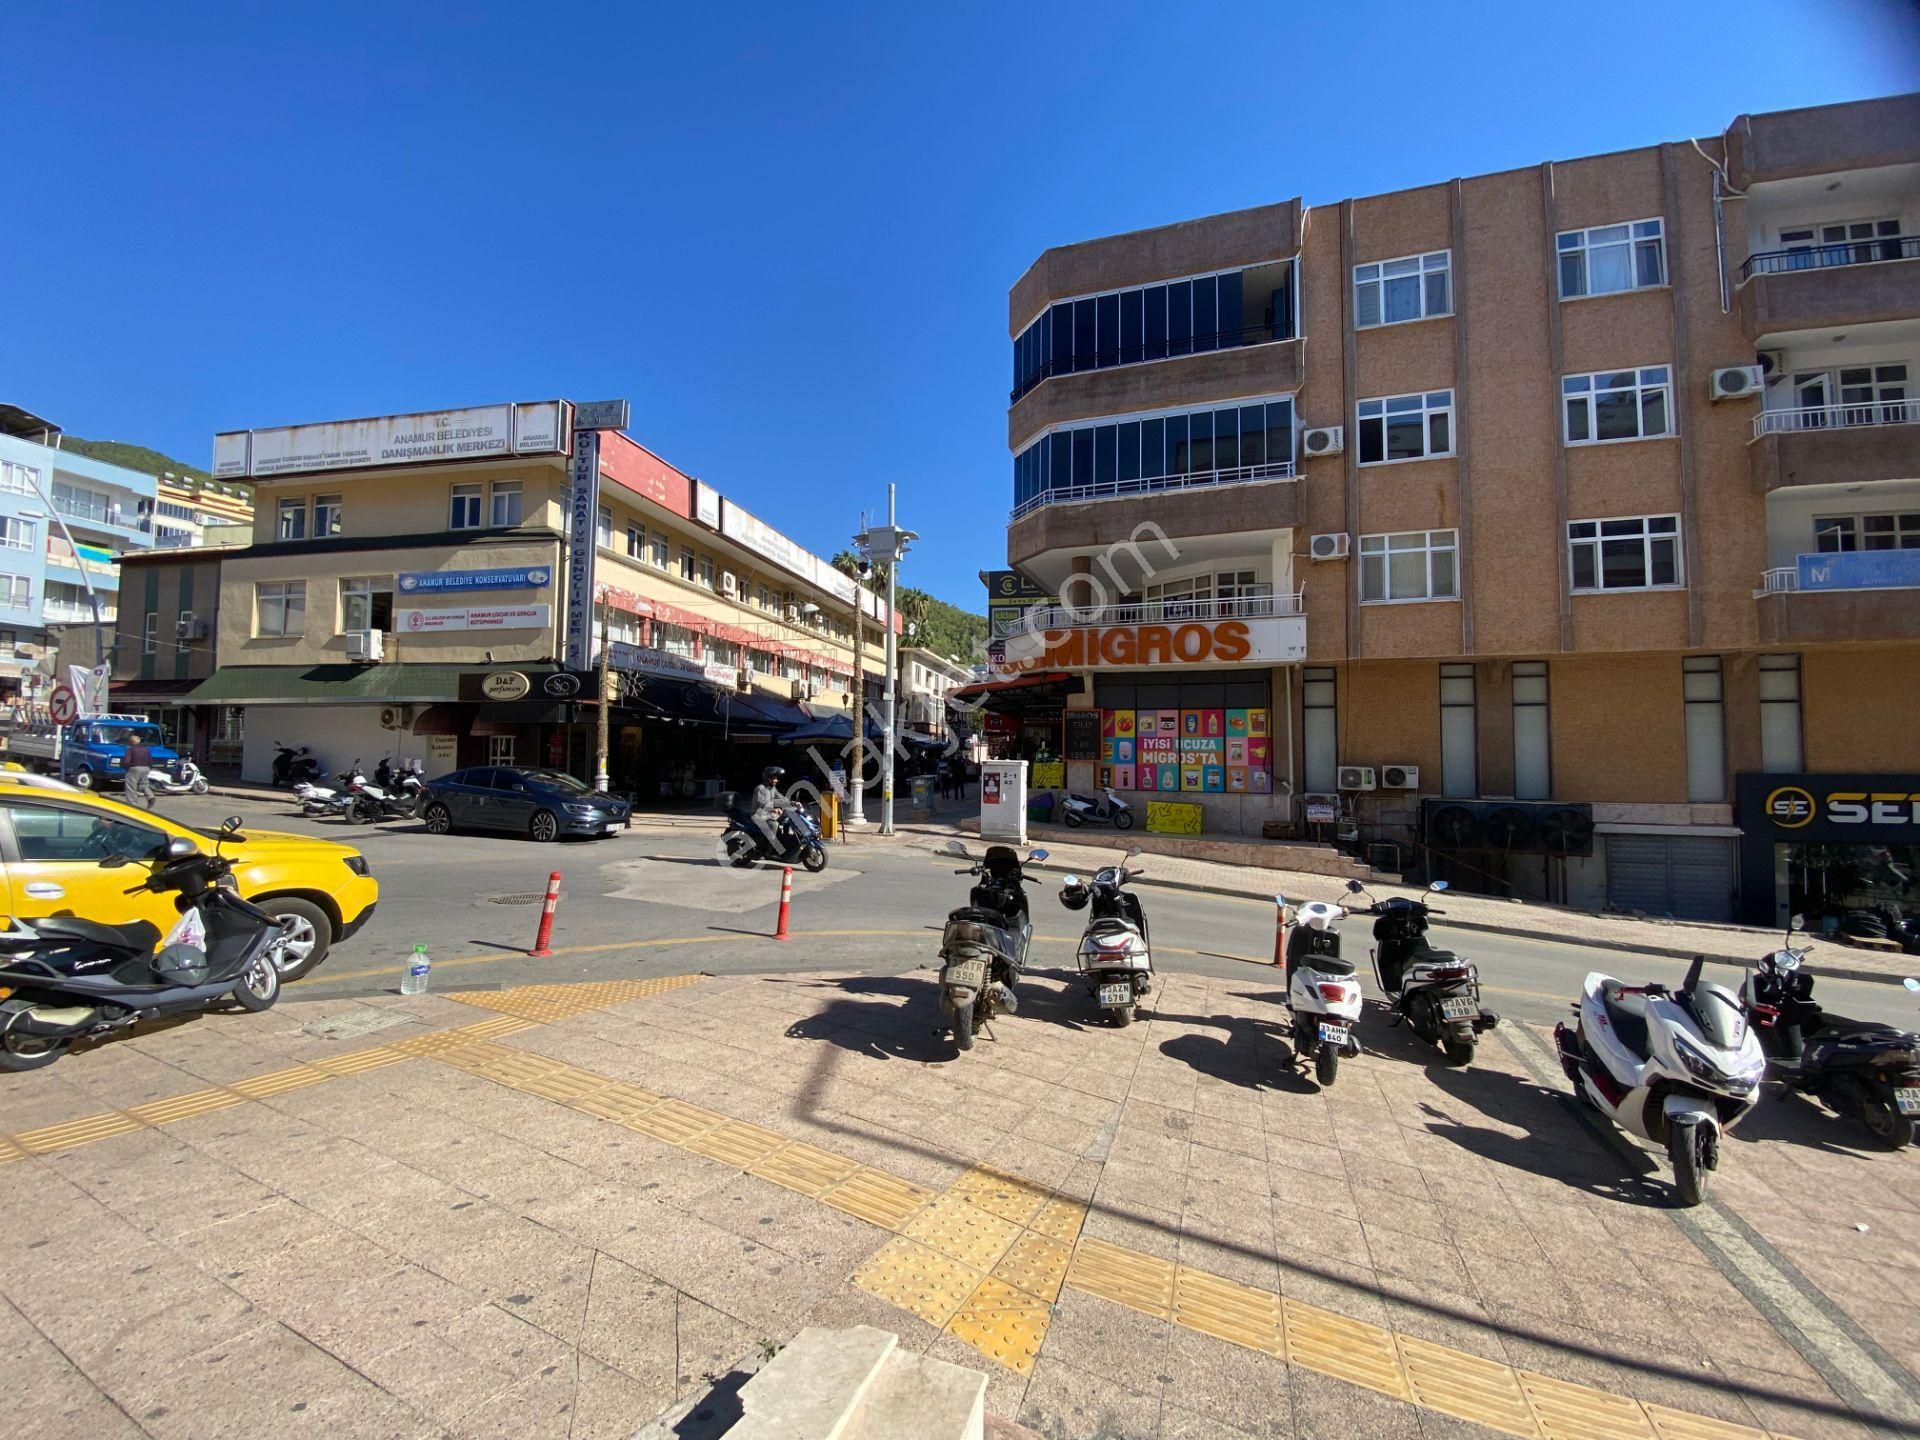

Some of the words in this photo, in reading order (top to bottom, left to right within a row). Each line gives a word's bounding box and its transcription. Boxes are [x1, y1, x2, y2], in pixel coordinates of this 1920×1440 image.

[394, 432, 434, 444] ANAMUR
[437, 427, 493, 440] BELEDİYESİ
[381, 443, 454, 459] DANIŞMANLIK
[457, 439, 505, 452] MERKEZİ
[419, 577, 443, 587] ANAMUR
[1175, 739, 1216, 750] UCUZA
